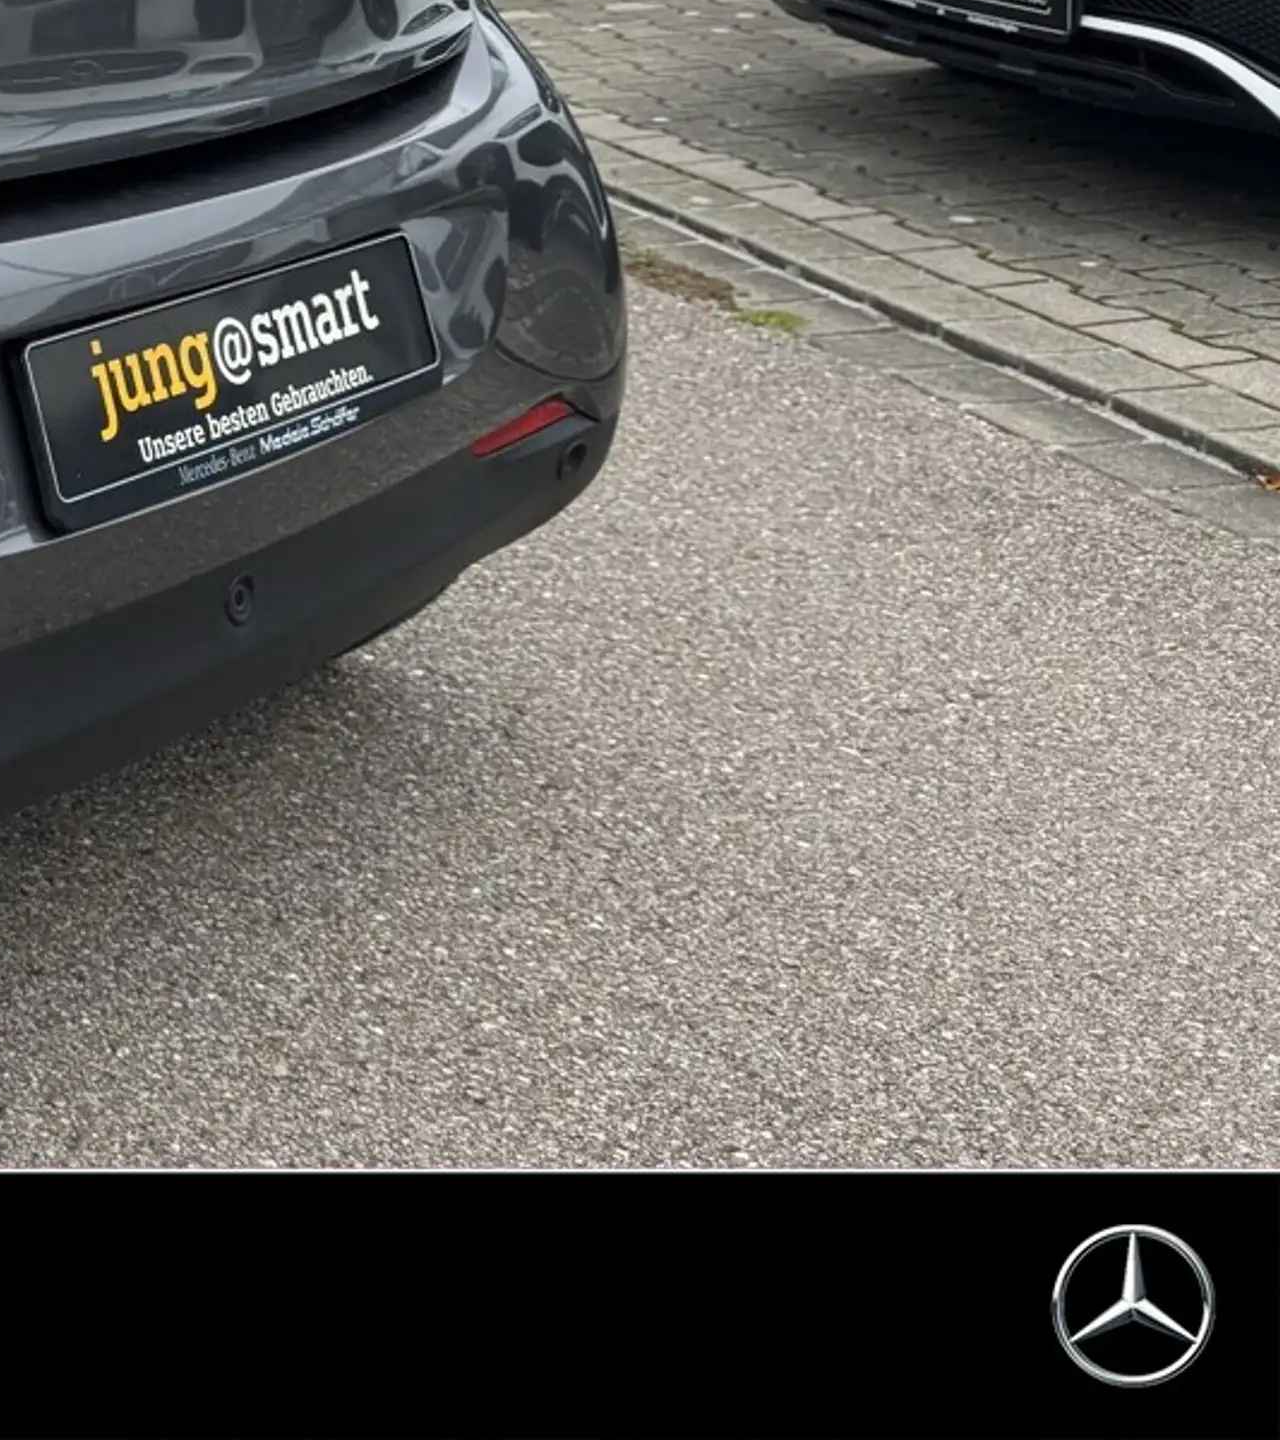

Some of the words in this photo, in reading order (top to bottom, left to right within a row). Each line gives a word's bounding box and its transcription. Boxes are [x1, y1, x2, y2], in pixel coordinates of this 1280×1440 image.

[91, 269, 380, 442] jung@smart
[138, 421, 207, 463] Unsere
[206, 400, 270, 440] besten
[270, 364, 374, 417] Gebrauchten.
[178, 444, 257, 486] Mercedes-Benz
